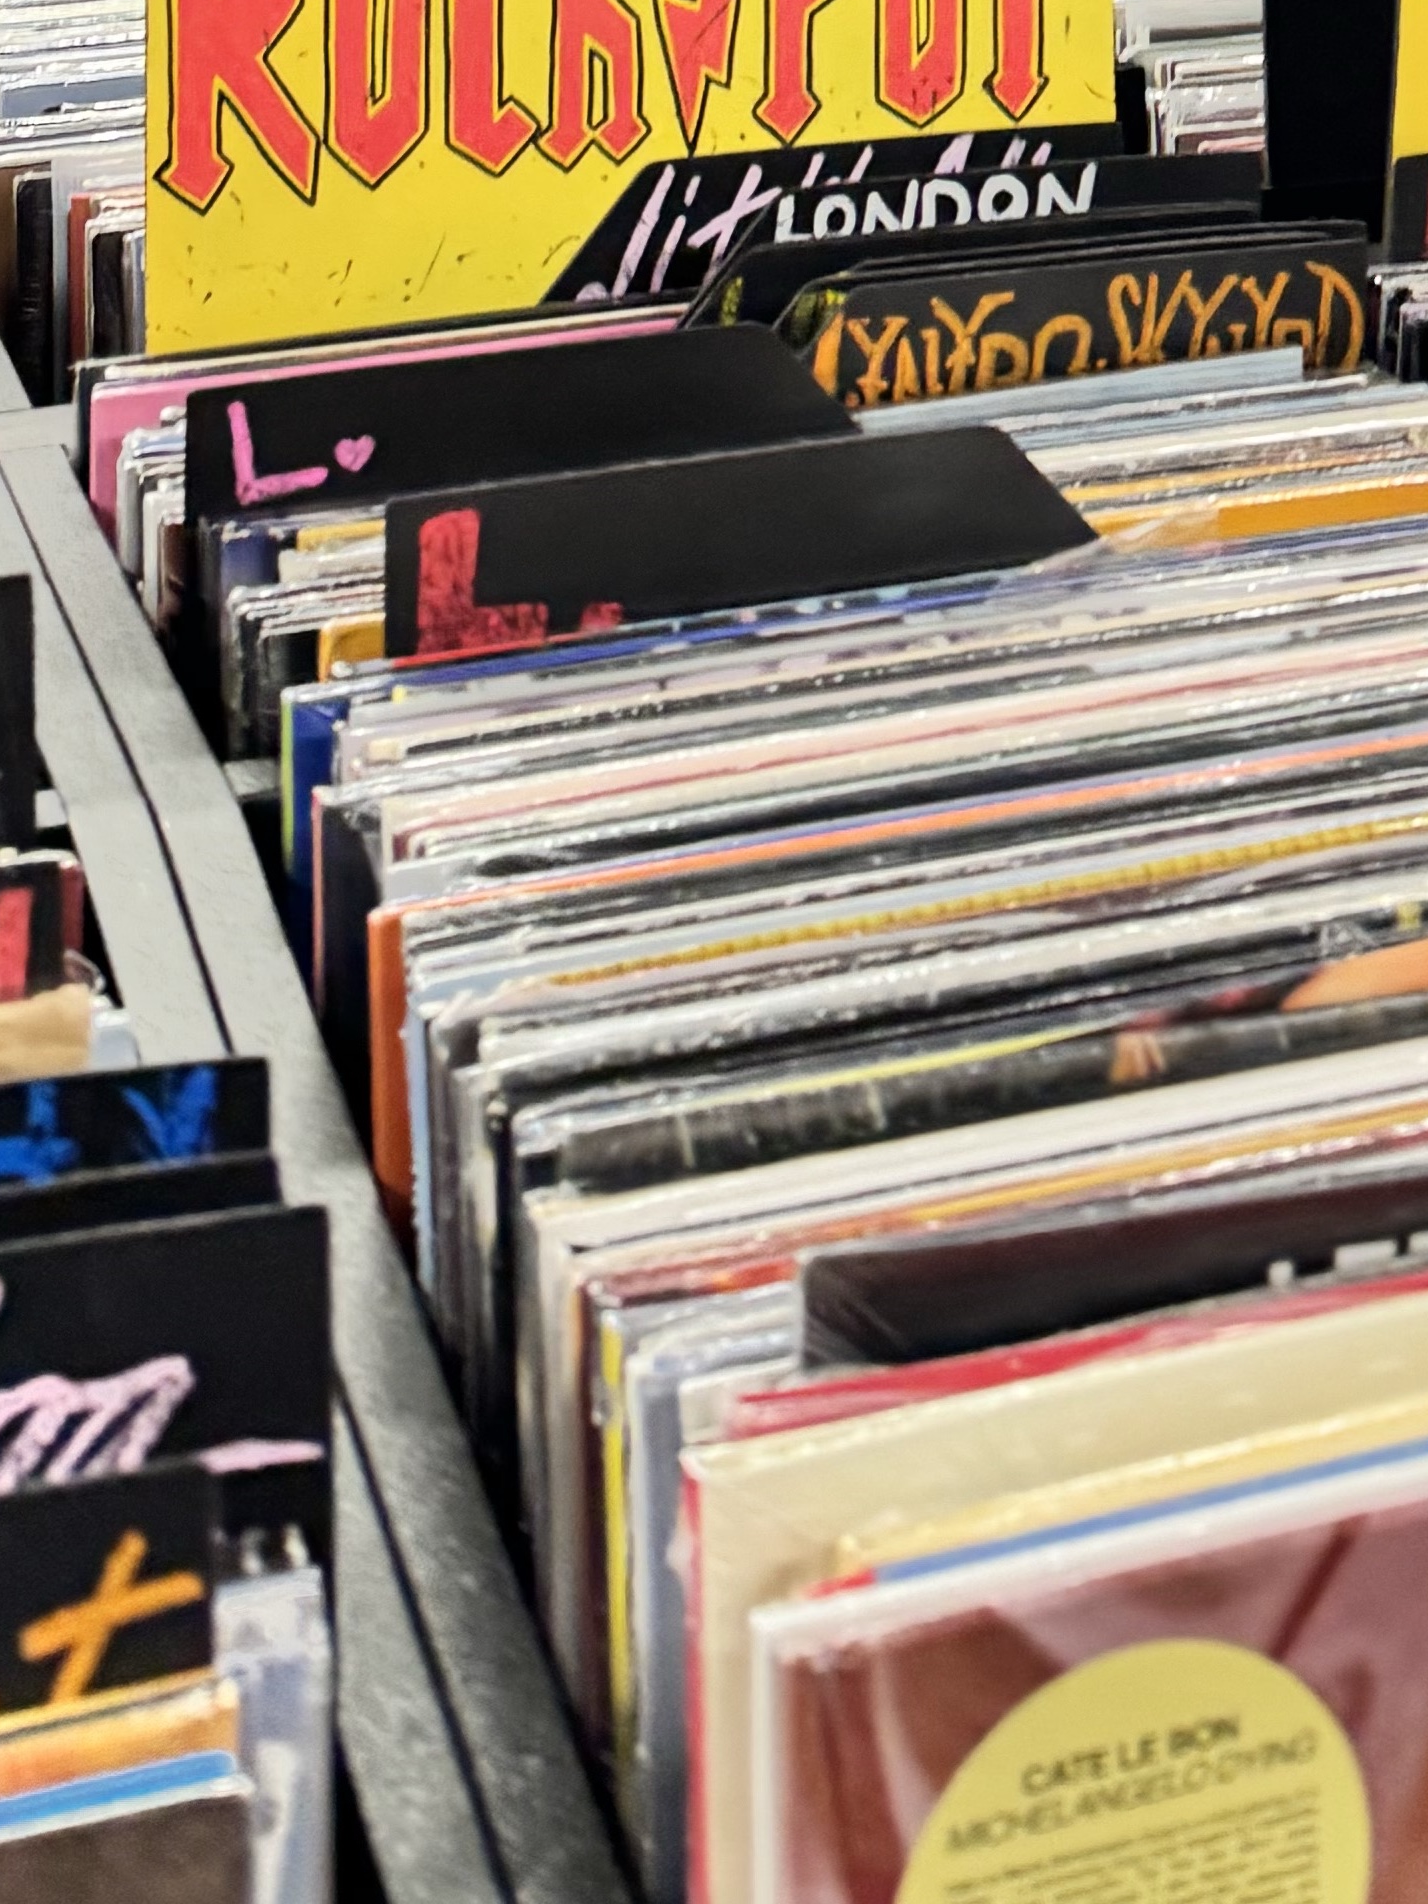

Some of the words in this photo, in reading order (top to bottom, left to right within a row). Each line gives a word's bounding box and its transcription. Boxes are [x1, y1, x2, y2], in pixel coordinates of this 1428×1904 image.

[775, 161, 1098, 244] LONDON
[1021, 1747, 1109, 1796] CATE
[1116, 1730, 1158, 1770] LE
[1169, 1713, 1240, 1757] BON
